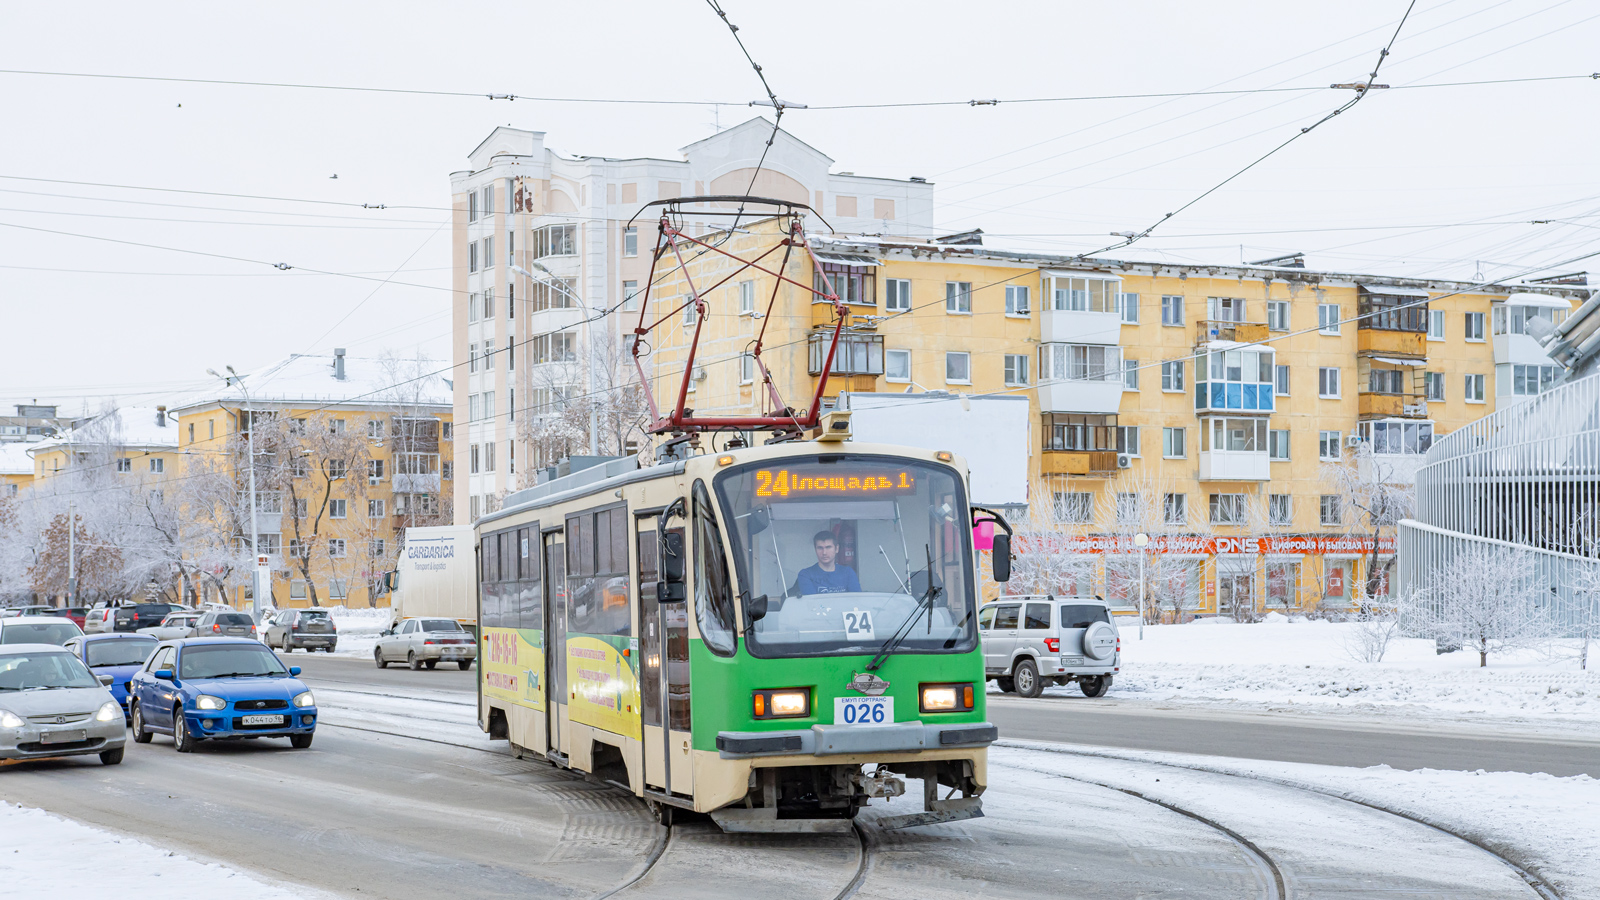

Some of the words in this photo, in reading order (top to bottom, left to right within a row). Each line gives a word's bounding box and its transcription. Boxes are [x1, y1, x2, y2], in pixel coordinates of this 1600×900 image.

[756, 470, 789, 496] 24
[408, 545, 454, 559] GARDARICA
[1216, 538, 1260, 553] DNS
[1272, 541, 1316, 550] ЦИФРОВАЯ
[1319, 541, 1325, 550] И
[1326, 541, 1362, 550] БЫТОВАЯ
[845, 612, 872, 633] 24
[843, 703, 885, 724] 026
